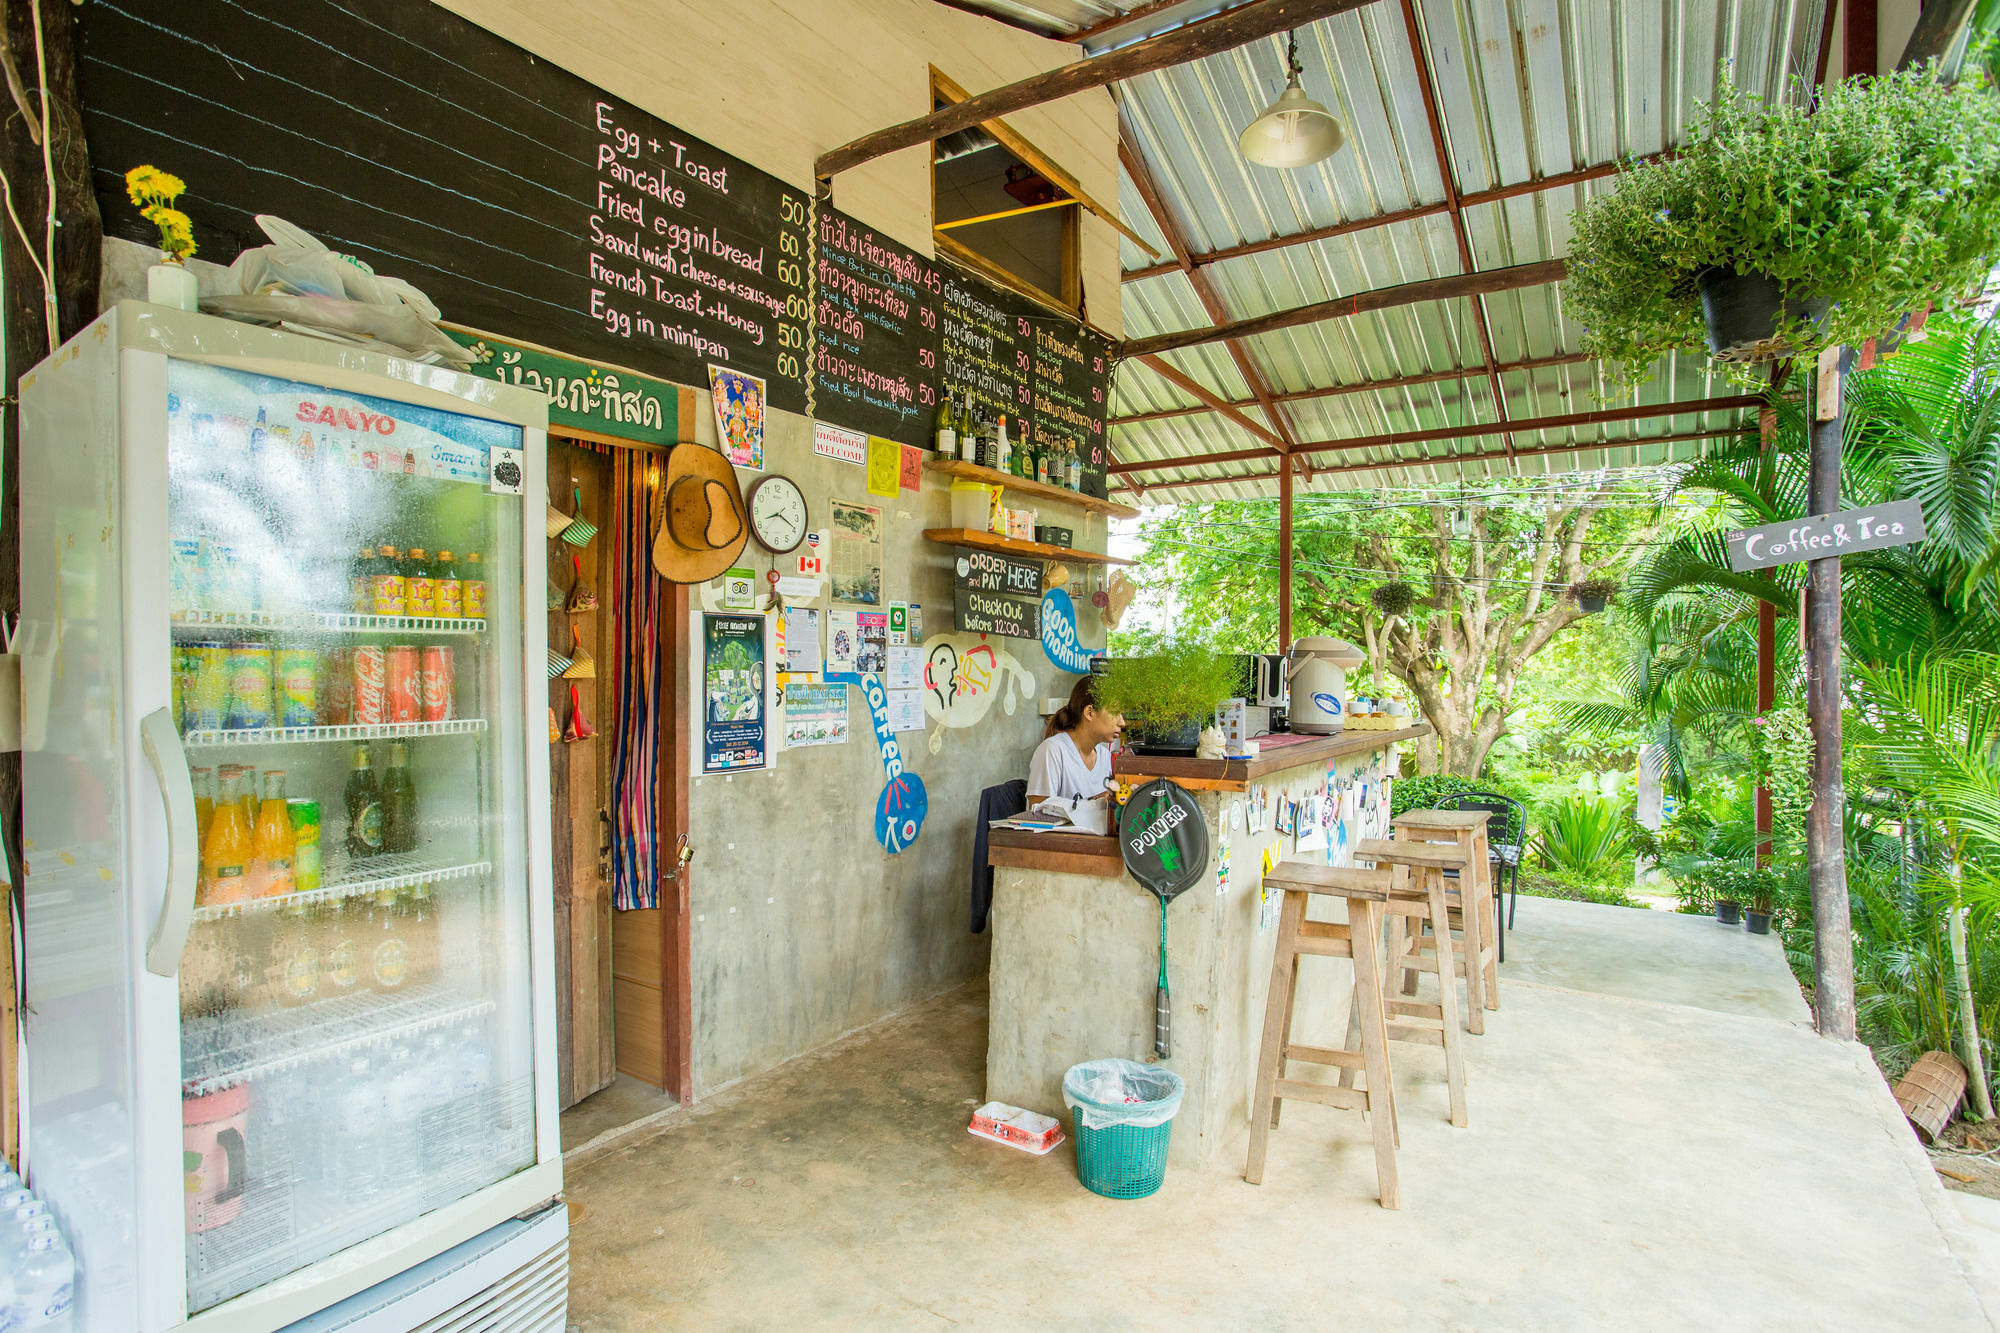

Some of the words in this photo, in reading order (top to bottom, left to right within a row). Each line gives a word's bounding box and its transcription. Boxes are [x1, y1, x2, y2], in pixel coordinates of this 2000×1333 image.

[596, 102, 640, 158] Egg
[647, 137, 661, 153] +
[669, 140, 729, 194] Toast
[597, 143, 686, 208] Pancake
[598, 180, 646, 228] Fried
[711, 227, 764, 276] bread
[590, 252, 647, 297] French
[650, 273, 706, 318] Toast
[869, 268, 879, 282] in
[923, 268, 941, 295] 45
[590, 288, 632, 339] Egg
[636, 310, 655, 338] in
[920, 307, 936, 330] 50
[819, 300, 864, 340] ข้าวผัด
[919, 348, 935, 369] 50
[1017, 317, 1031, 338] 50
[818, 330, 839, 346] Fried
[1016, 350, 1030, 372] 50
[1093, 356, 1104, 375] 50
[496, 351, 664, 431] บ้านกะทิสด
[819, 375, 840, 393] Fried
[919, 382, 936, 406] 50
[1018, 385, 1031, 405] 50
[1091, 386, 1103, 404] 50
[295, 401, 396, 436] SANYO
[1092, 418, 1102, 435] 60
[816, 443, 865, 463] WELCOME
[1091, 446, 1102, 465] 60
[757, 494, 764, 503] 10
[764, 486, 770, 495] 11
[774, 484, 782, 493] 12
[754, 507, 759, 515] 9
[792, 502, 797, 510] 2
[757, 521, 763, 529] 8
[794, 514, 799, 522] 3
[1856, 515, 1905, 541] Tea
[774, 536, 780, 545] 6
[784, 534, 790, 543] 5
[968, 576, 981, 588] and
[981, 572, 1002, 591] PAY
[969, 553, 1006, 574] ORDER
[1007, 565, 1038, 590] HERE
[969, 593, 1002, 616] Check
[1002, 601, 1023, 621] Out
[964, 613, 992, 632] before
[994, 619, 1020, 637] 12:00
[1129, 804, 1188, 856] POWER
